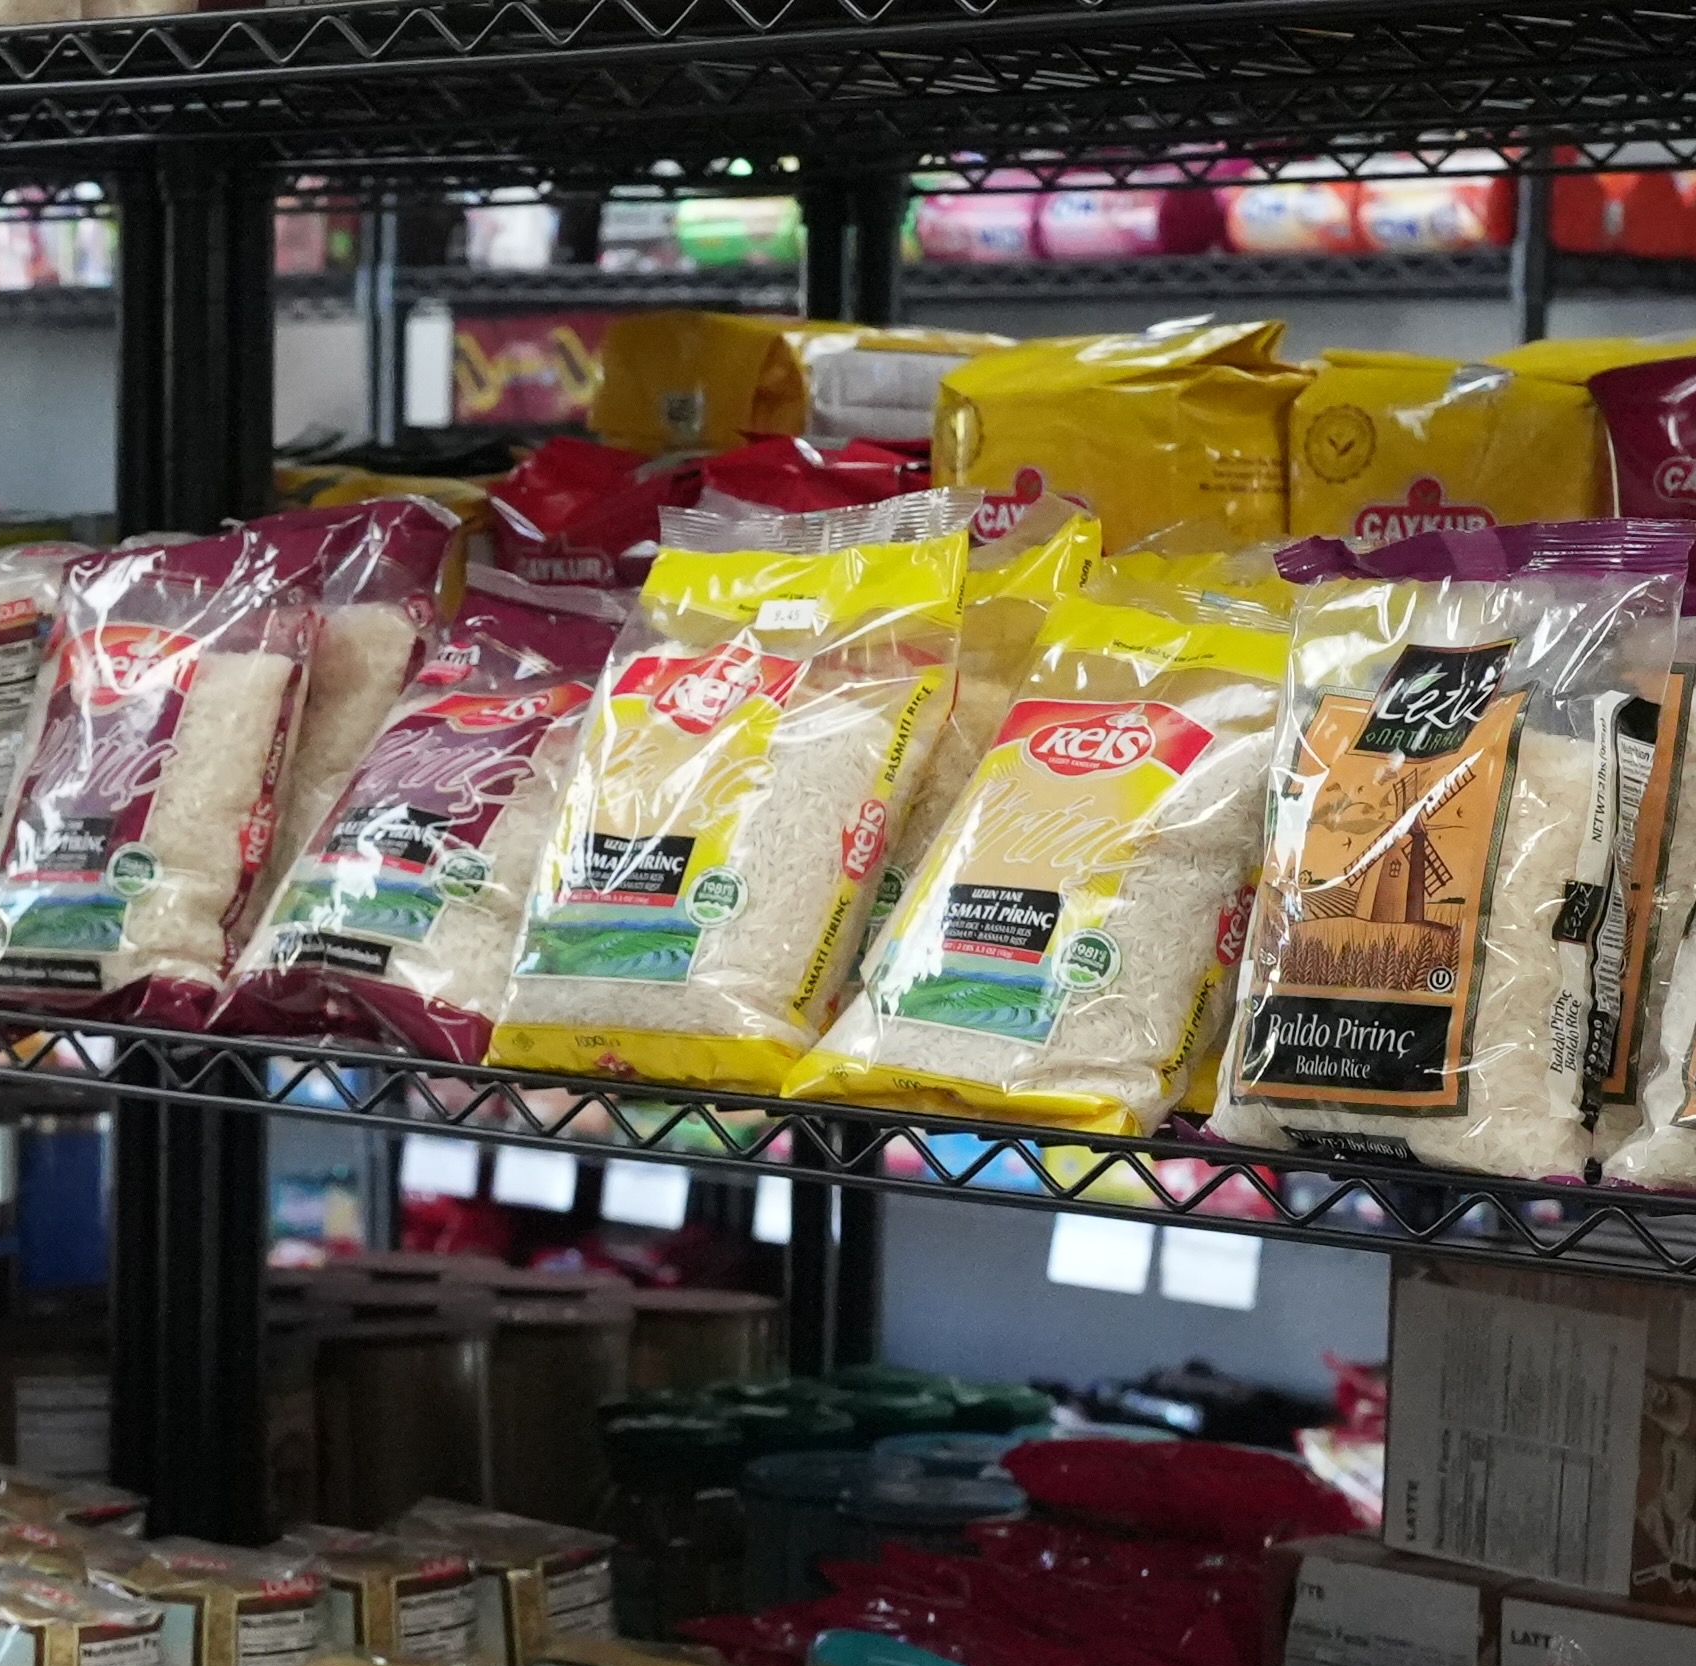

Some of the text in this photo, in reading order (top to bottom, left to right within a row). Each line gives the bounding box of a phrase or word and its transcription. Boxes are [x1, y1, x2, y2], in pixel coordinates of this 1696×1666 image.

[1040, 723, 1149, 763] Reis
[846, 804, 887, 876] Reis
[998, 904, 1055, 931] PİRİNÇ
[1223, 892, 1257, 961] Reis
[1567, 999, 1581, 1031] Rice
[1268, 1012, 1415, 1059] Baldo Pirinç
[1550, 1031, 1565, 1075] Baldo
[1295, 1053, 1372, 1080] Baldo Rice
[1510, 1627, 1552, 1650] LATT
